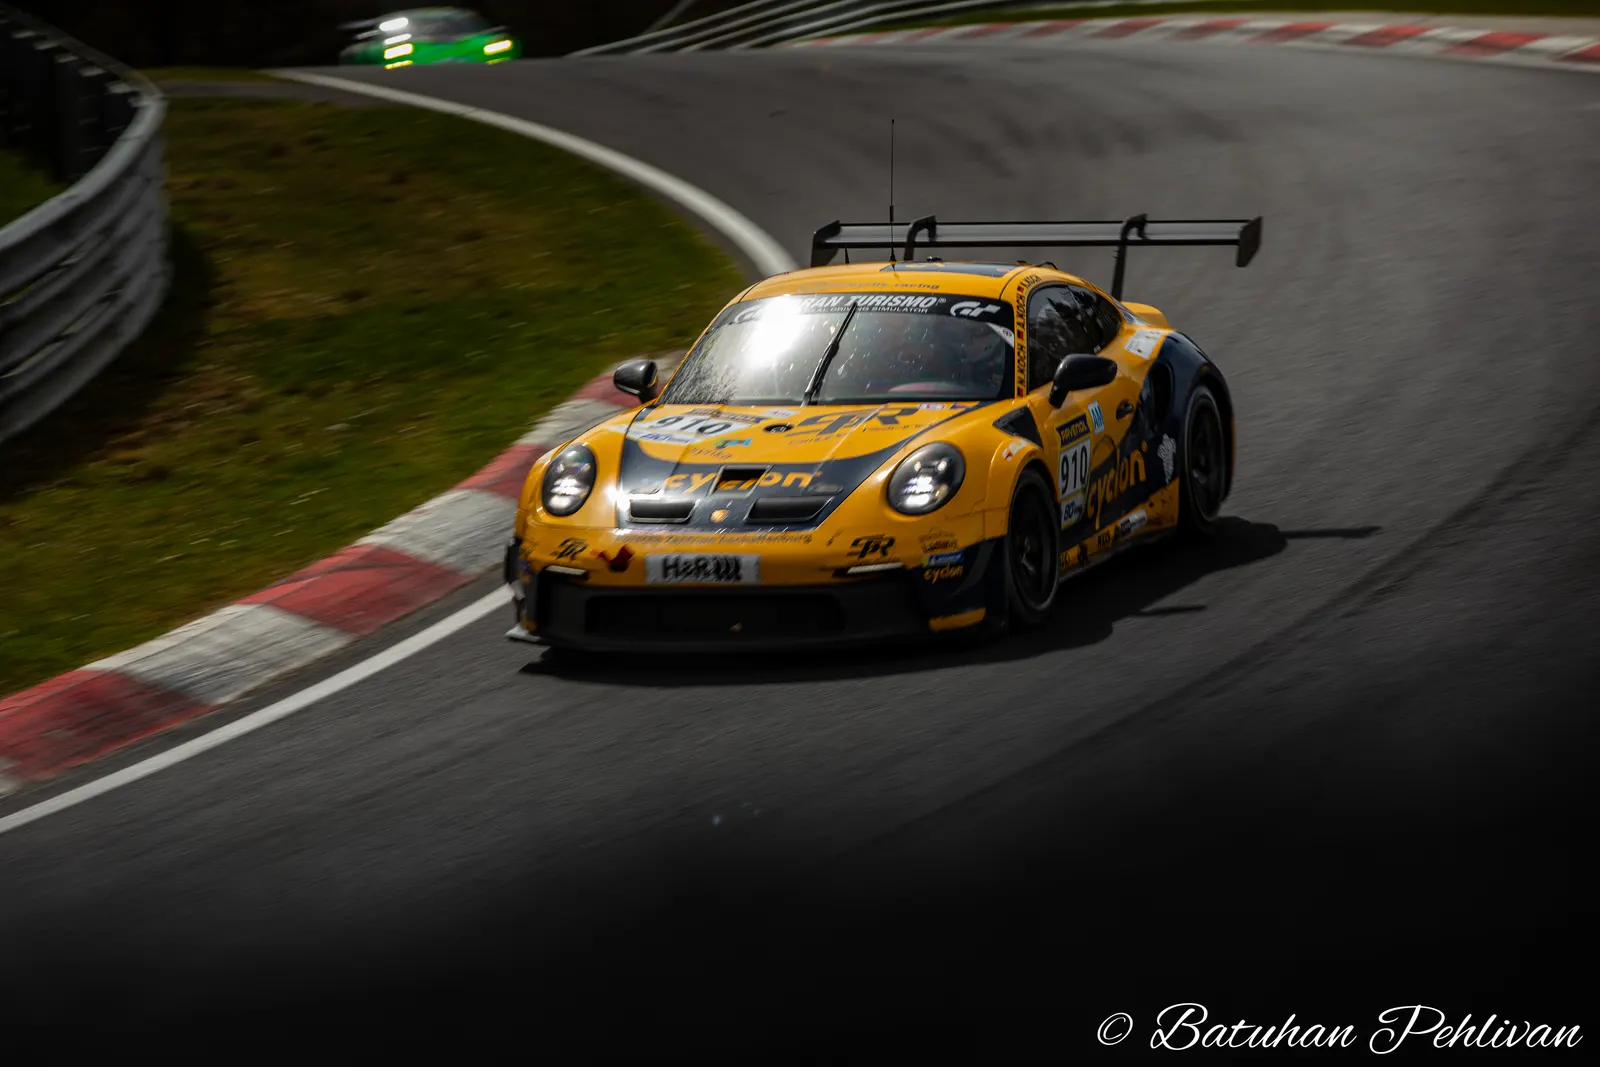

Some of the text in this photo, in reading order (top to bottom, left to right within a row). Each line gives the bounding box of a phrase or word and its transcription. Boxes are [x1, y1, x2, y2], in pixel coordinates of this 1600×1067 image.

[790, 295, 843, 308] RAN
[871, 306, 928, 314] SIMULATOR
[648, 415, 732, 435] 910
[1061, 445, 1087, 494] 910
[1086, 447, 1147, 532] cyclon
[923, 564, 964, 584] cyclon
